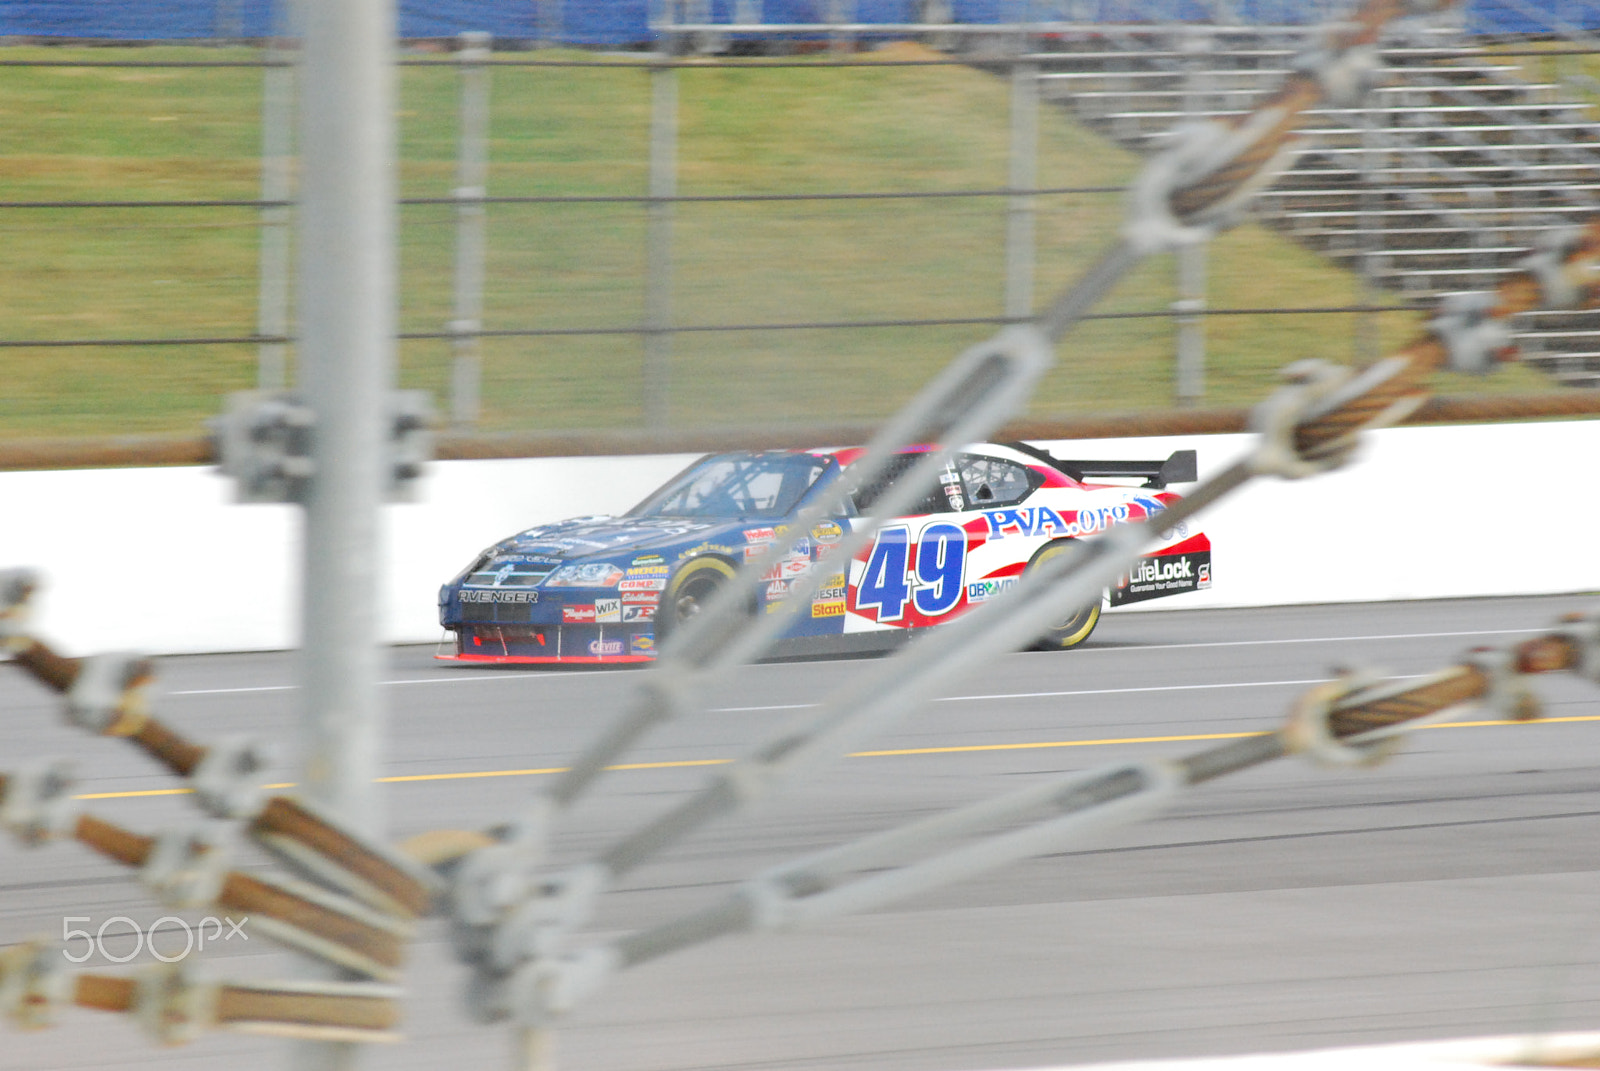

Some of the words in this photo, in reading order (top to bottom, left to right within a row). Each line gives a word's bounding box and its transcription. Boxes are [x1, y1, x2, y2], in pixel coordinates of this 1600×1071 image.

[627, 566, 668, 576] MOOG
[857, 523, 967, 622] 49
[621, 580, 653, 588] COMP
[459, 590, 538, 603] AVENGER
[596, 600, 618, 614] WIX
[624, 606, 655, 620] JE
[813, 603, 845, 617] Stant
